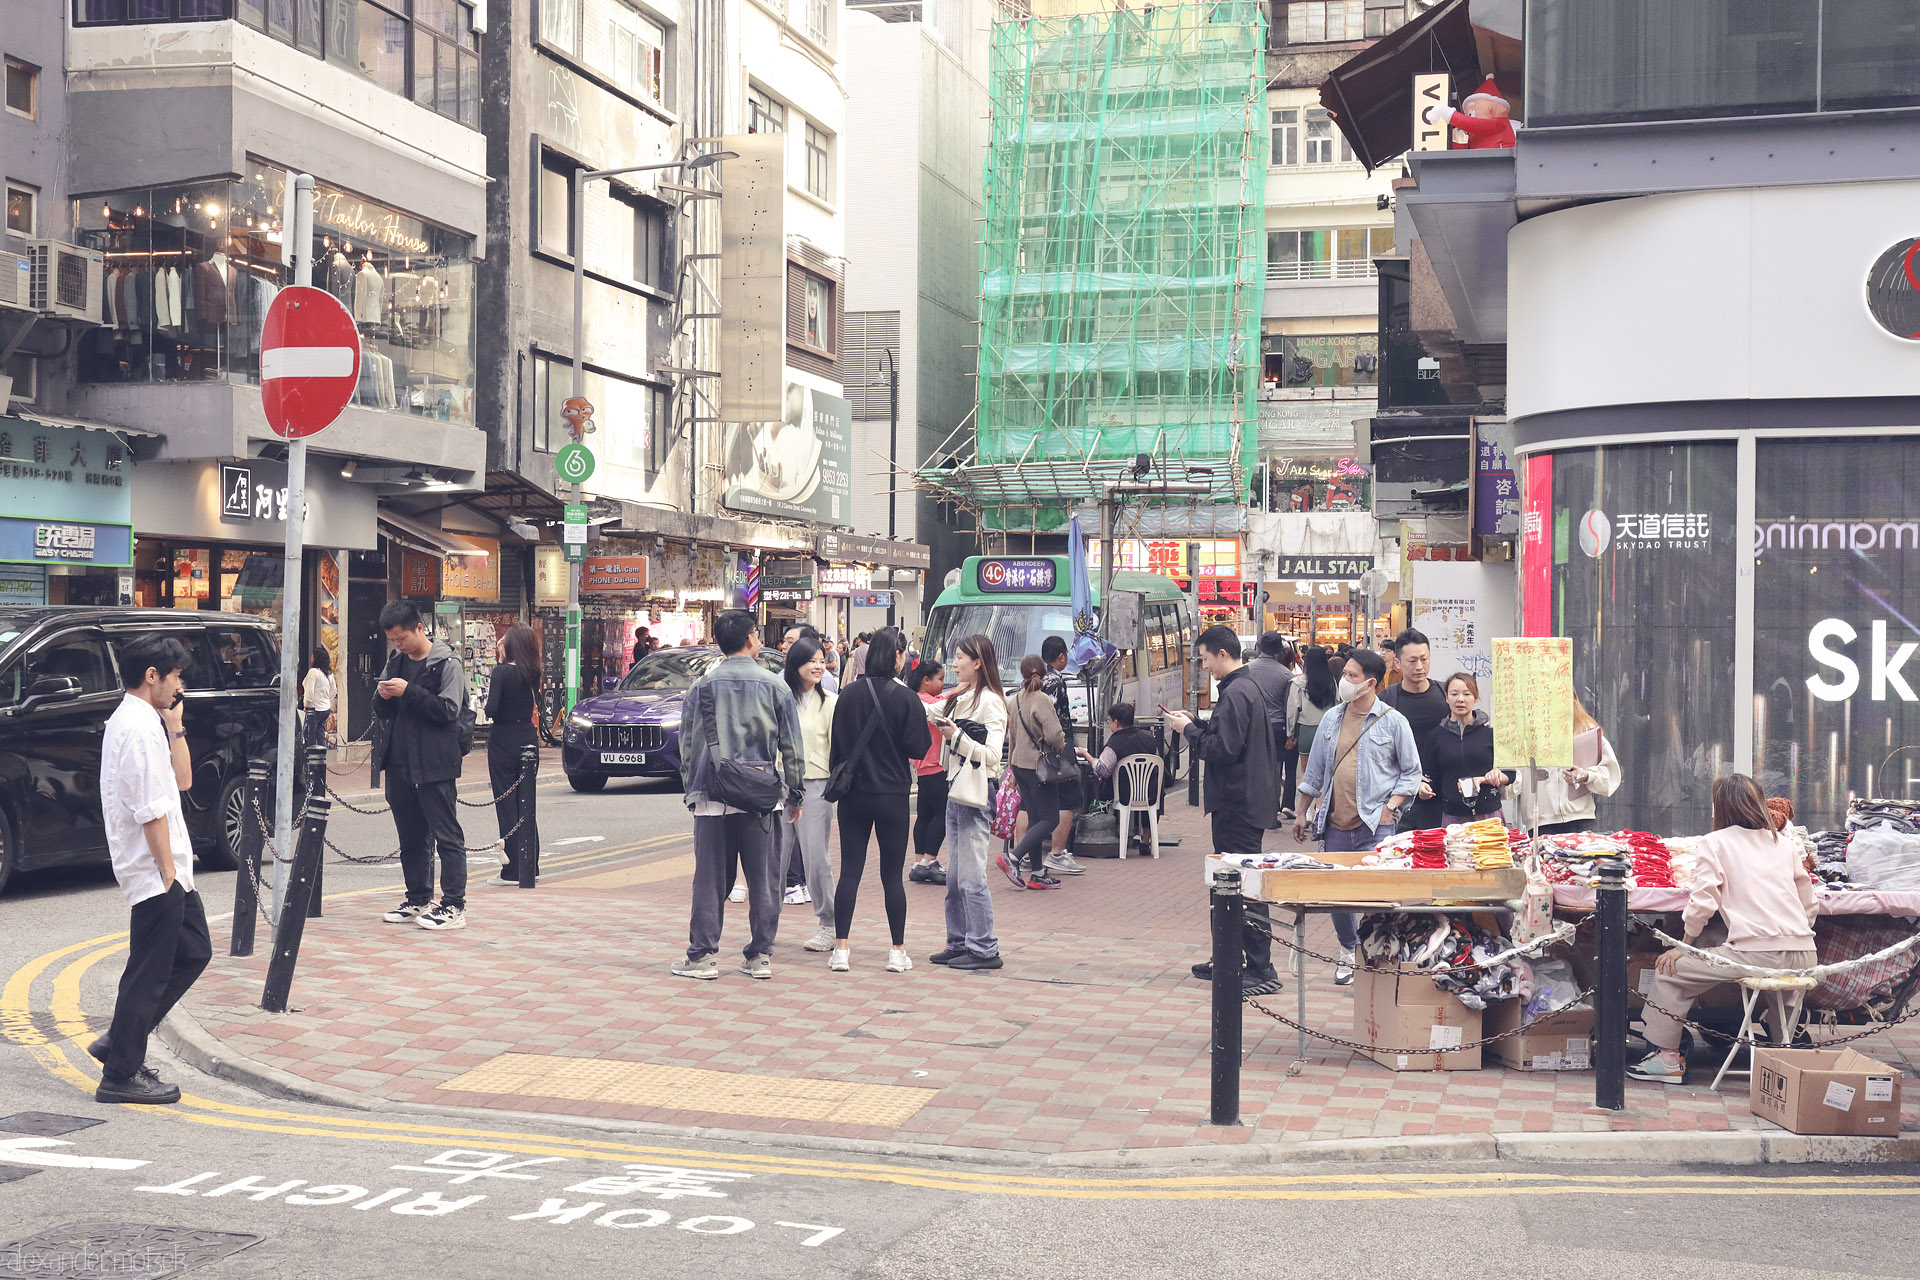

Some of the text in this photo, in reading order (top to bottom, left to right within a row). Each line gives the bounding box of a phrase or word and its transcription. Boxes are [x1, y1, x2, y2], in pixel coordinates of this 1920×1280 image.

[327, 193, 378, 236] Tailor
[383, 215, 429, 253] House
[1296, 337, 1356, 347] HONG KONG
[1276, 457, 1293, 475] J
[1290, 465, 1308, 475] All
[255, 484, 310, 520] 阿里
[1616, 512, 1710, 539] 天道信託
[1616, 540, 1707, 550] SKYDAO TRUST
[35, 547, 94, 559] EASY CHARGE
[985, 565, 1002, 581] 4C
[1282, 561, 1370, 574] J ALL STAR
[410, 561, 429, 592] 電訊
[444, 573, 469, 588] PHONE
[614, 576, 639, 584] Dai-Ichi
[16, 581, 35, 593] HK
[1805, 618, 1920, 702] Sk
[603, 754, 643, 763] VU 6968
[133, 1171, 845, 1247] LOOK RIGHT
